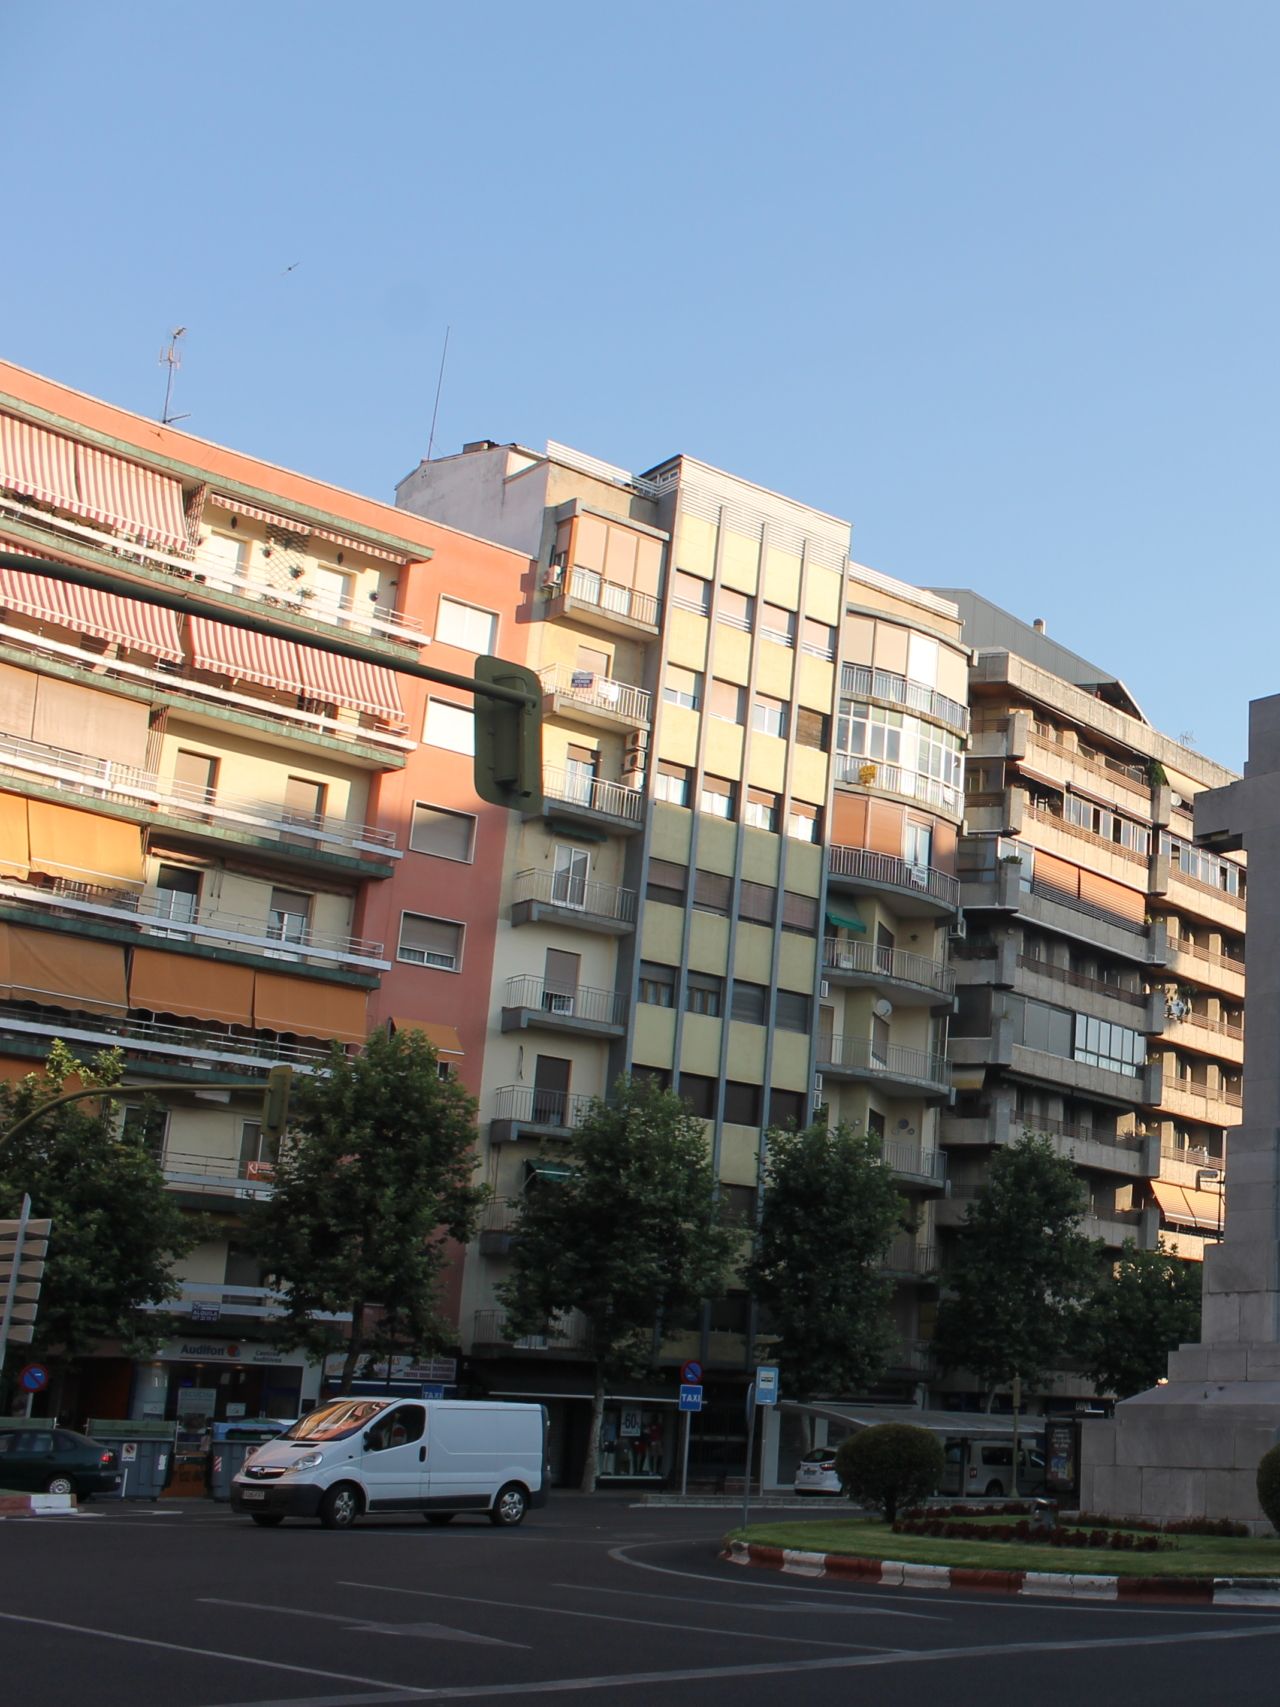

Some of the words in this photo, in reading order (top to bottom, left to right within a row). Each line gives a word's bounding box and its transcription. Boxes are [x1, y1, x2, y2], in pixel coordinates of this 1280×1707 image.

[181, 1344, 225, 1355] Audifon
[424, 1392, 442, 1400] TAXI
[681, 1394, 701, 1402] TAXI
